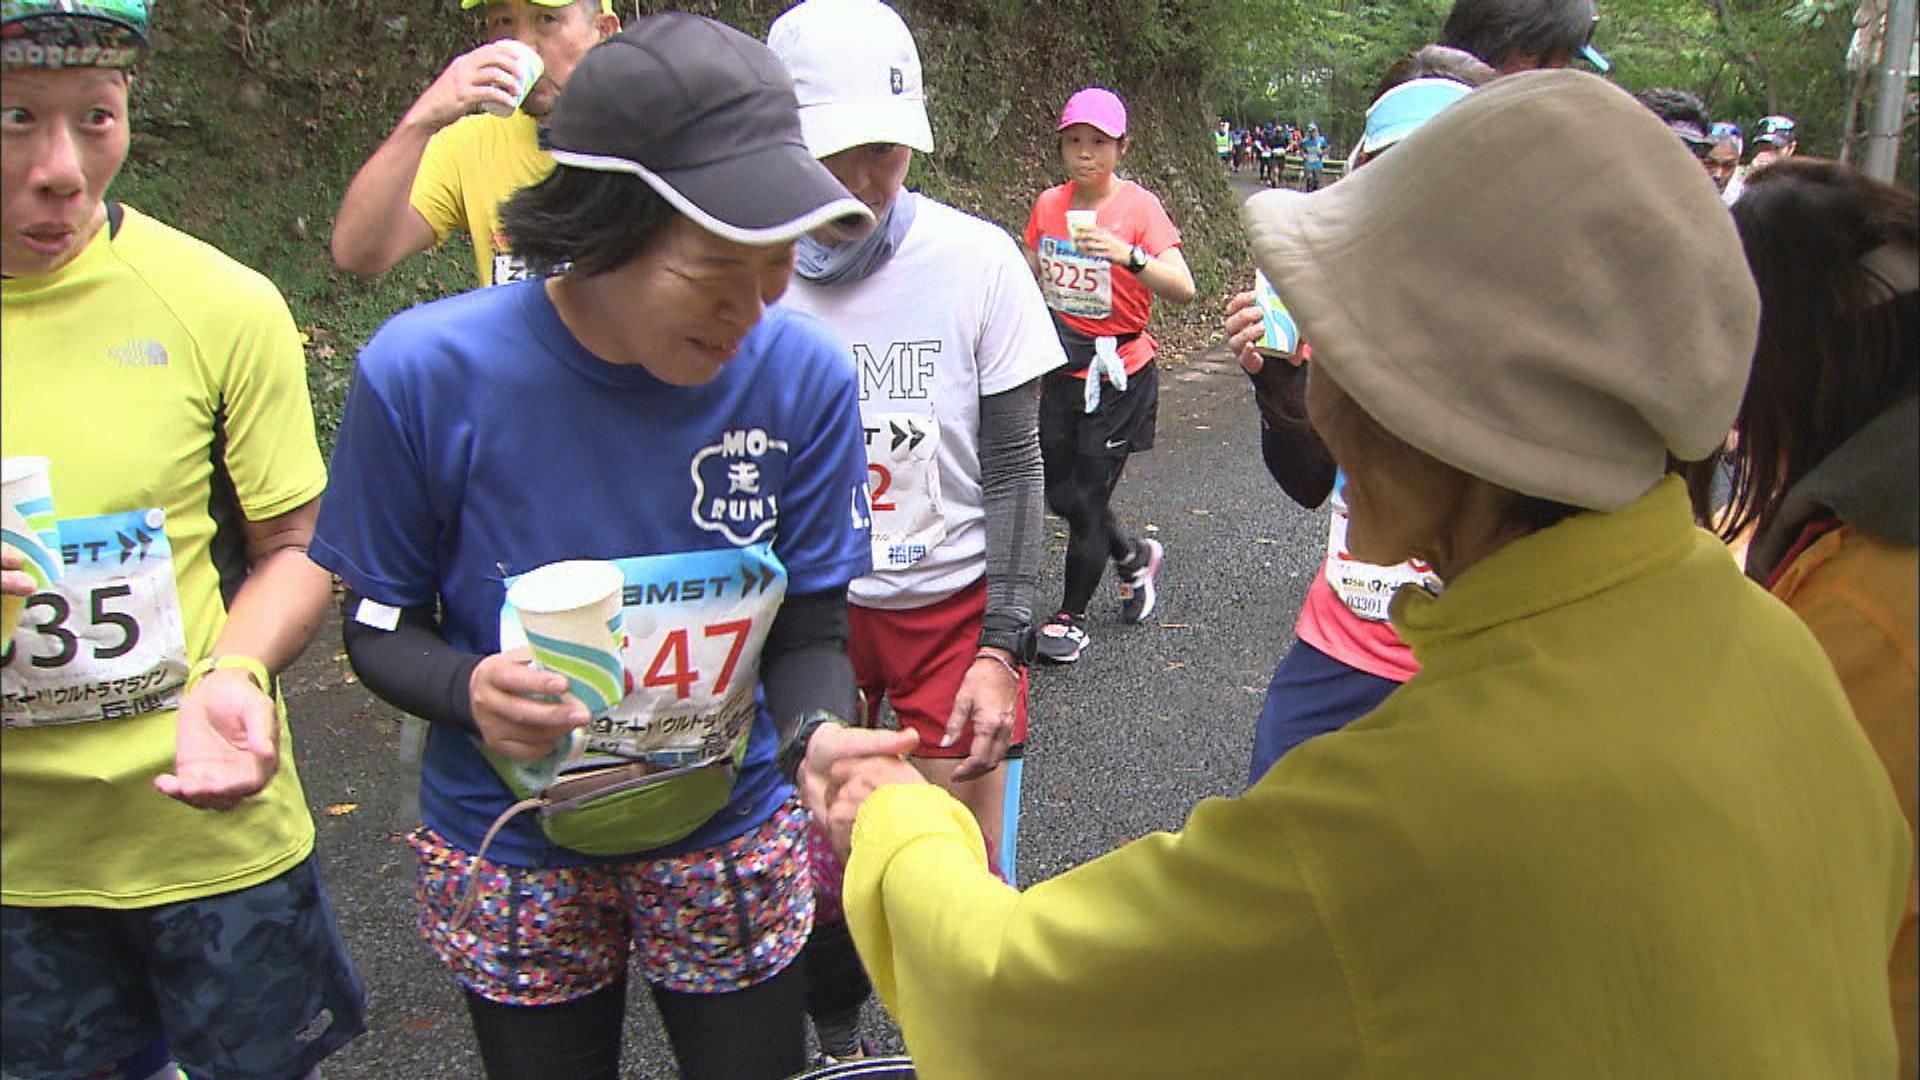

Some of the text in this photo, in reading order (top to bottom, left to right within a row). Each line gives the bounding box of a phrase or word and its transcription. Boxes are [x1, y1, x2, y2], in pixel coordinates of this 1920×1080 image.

[853, 340, 942, 400] MF
[728, 461, 760, 495] 走
[888, 543, 926, 566] 福岡
[1, 584, 140, 668] 35
[624, 618, 753, 700] 47
